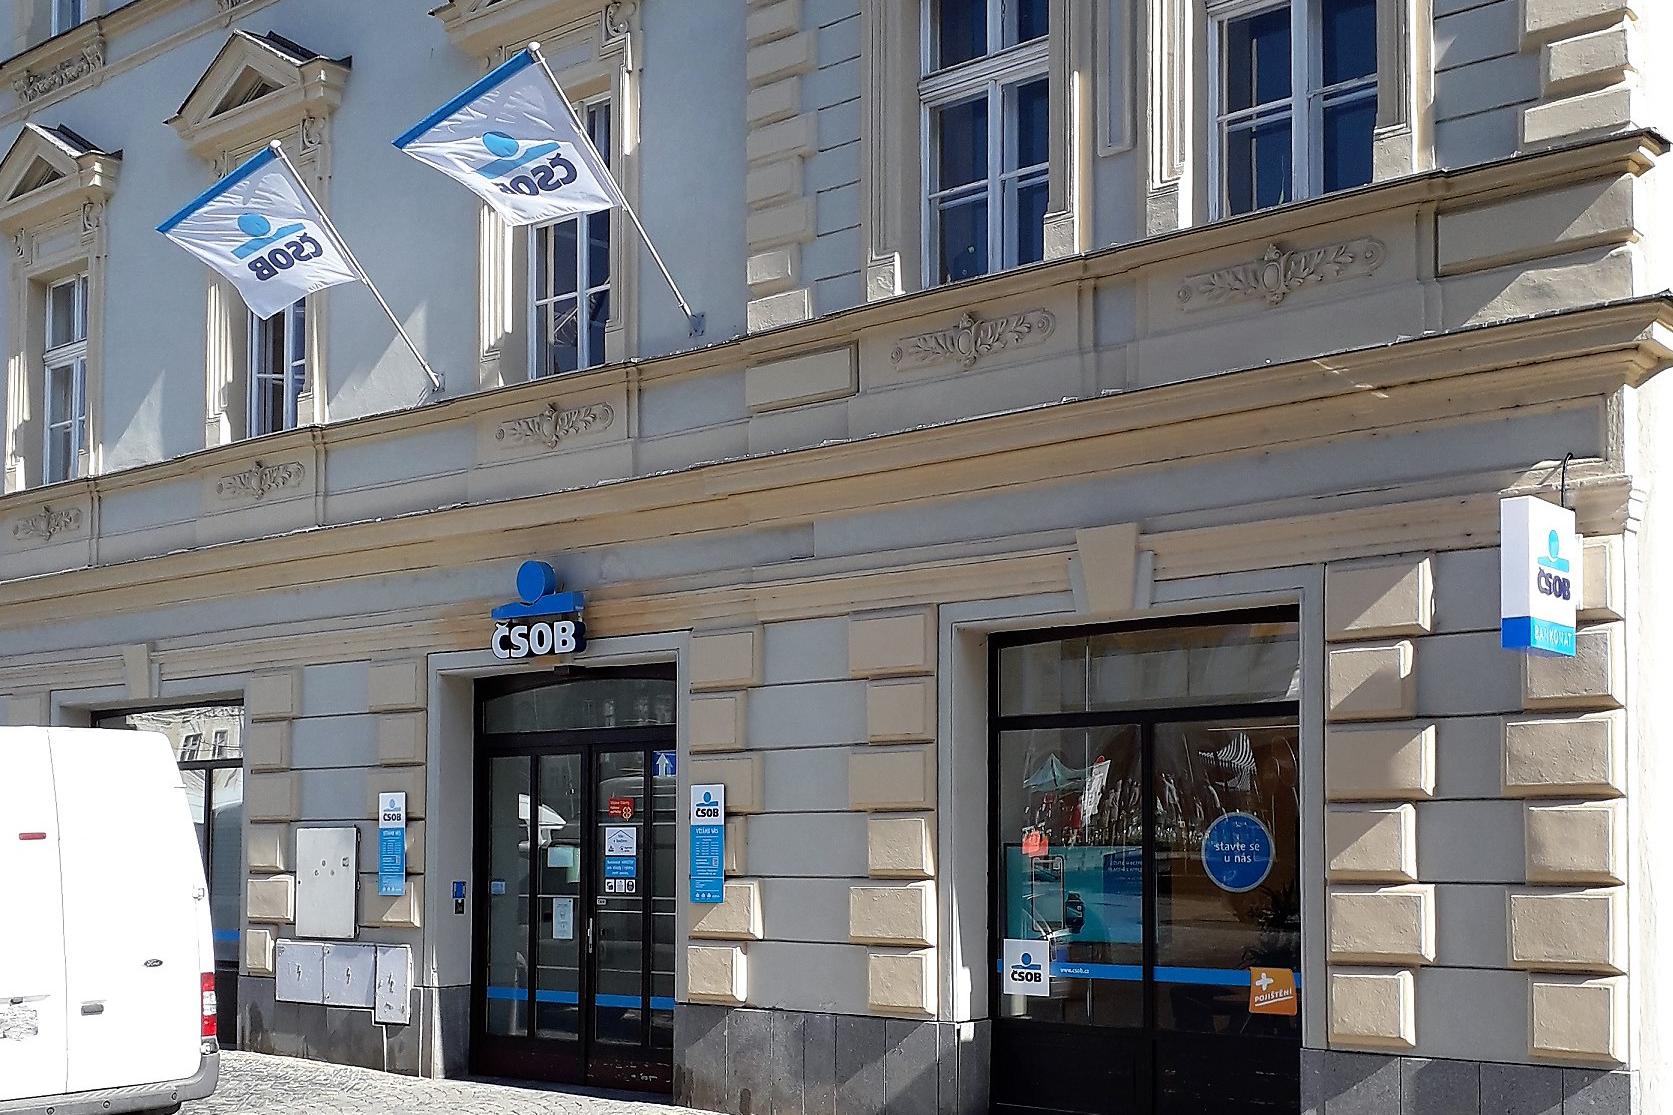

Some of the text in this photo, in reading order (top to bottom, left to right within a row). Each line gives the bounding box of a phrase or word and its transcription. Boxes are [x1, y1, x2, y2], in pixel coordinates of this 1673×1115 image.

[1537, 567, 1571, 601] ČSOB
[491, 620, 577, 659] ČSOB
[695, 807, 720, 818] ČSOB
[1215, 841, 1260, 851] stavte se
[1224, 851, 1252, 863] u nás
[1010, 970, 1042, 983] ČSOB
